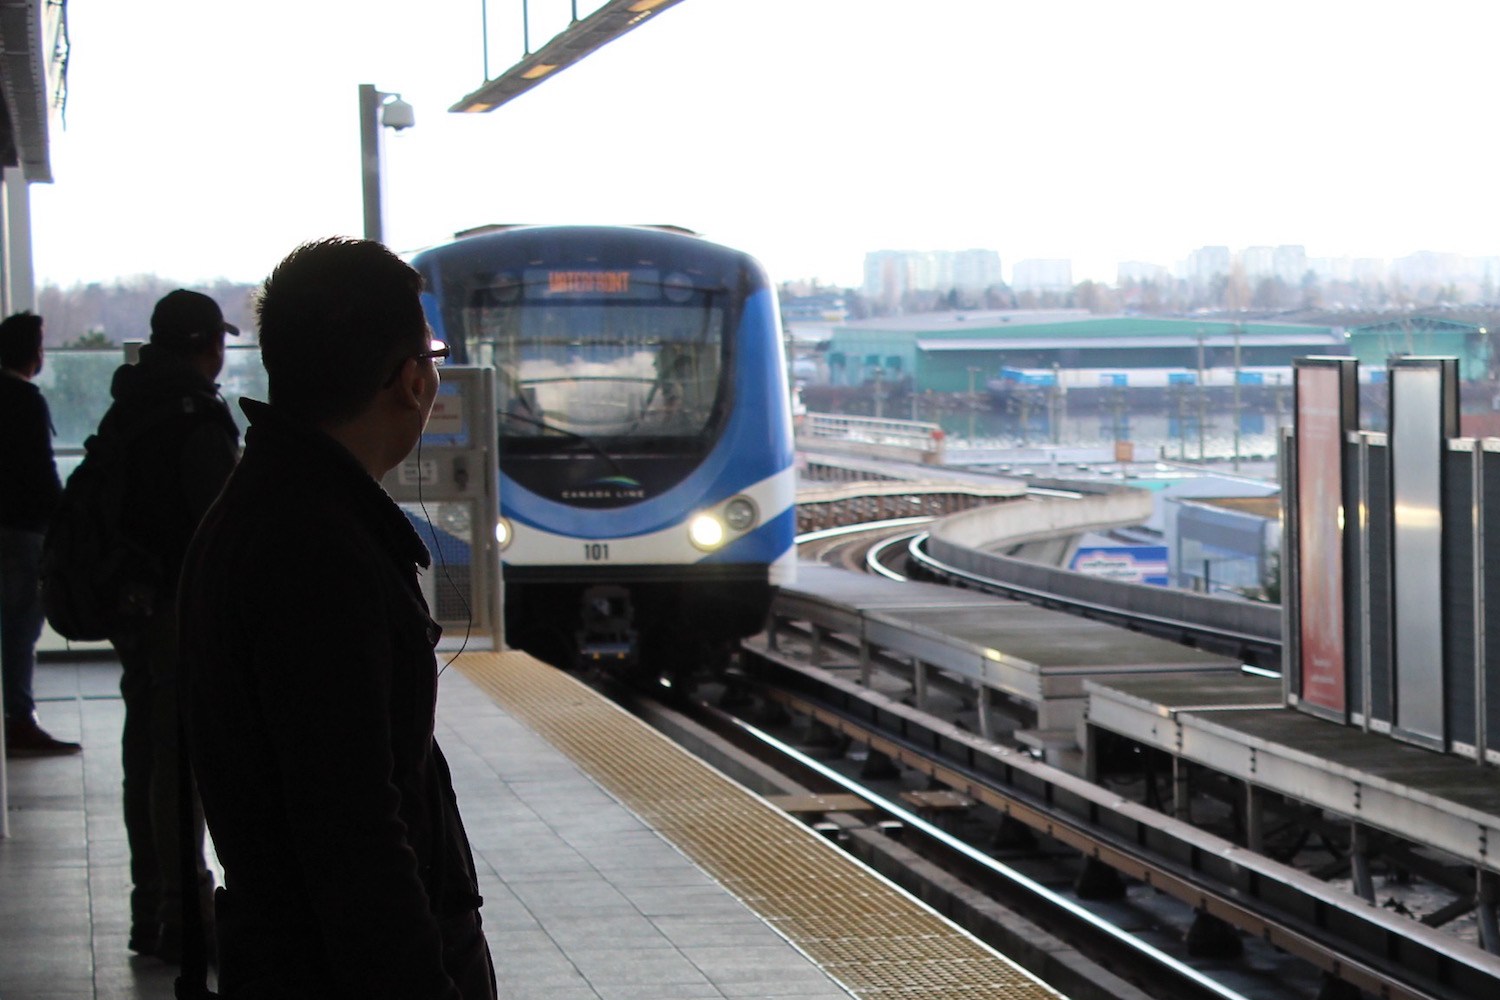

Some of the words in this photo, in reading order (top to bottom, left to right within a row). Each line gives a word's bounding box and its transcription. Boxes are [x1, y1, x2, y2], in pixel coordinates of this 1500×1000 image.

[549, 271, 629, 293] WATERFRONT
[561, 490, 611, 499] CANADA
[615, 489, 645, 499] LINE
[585, 543, 609, 560] 101
